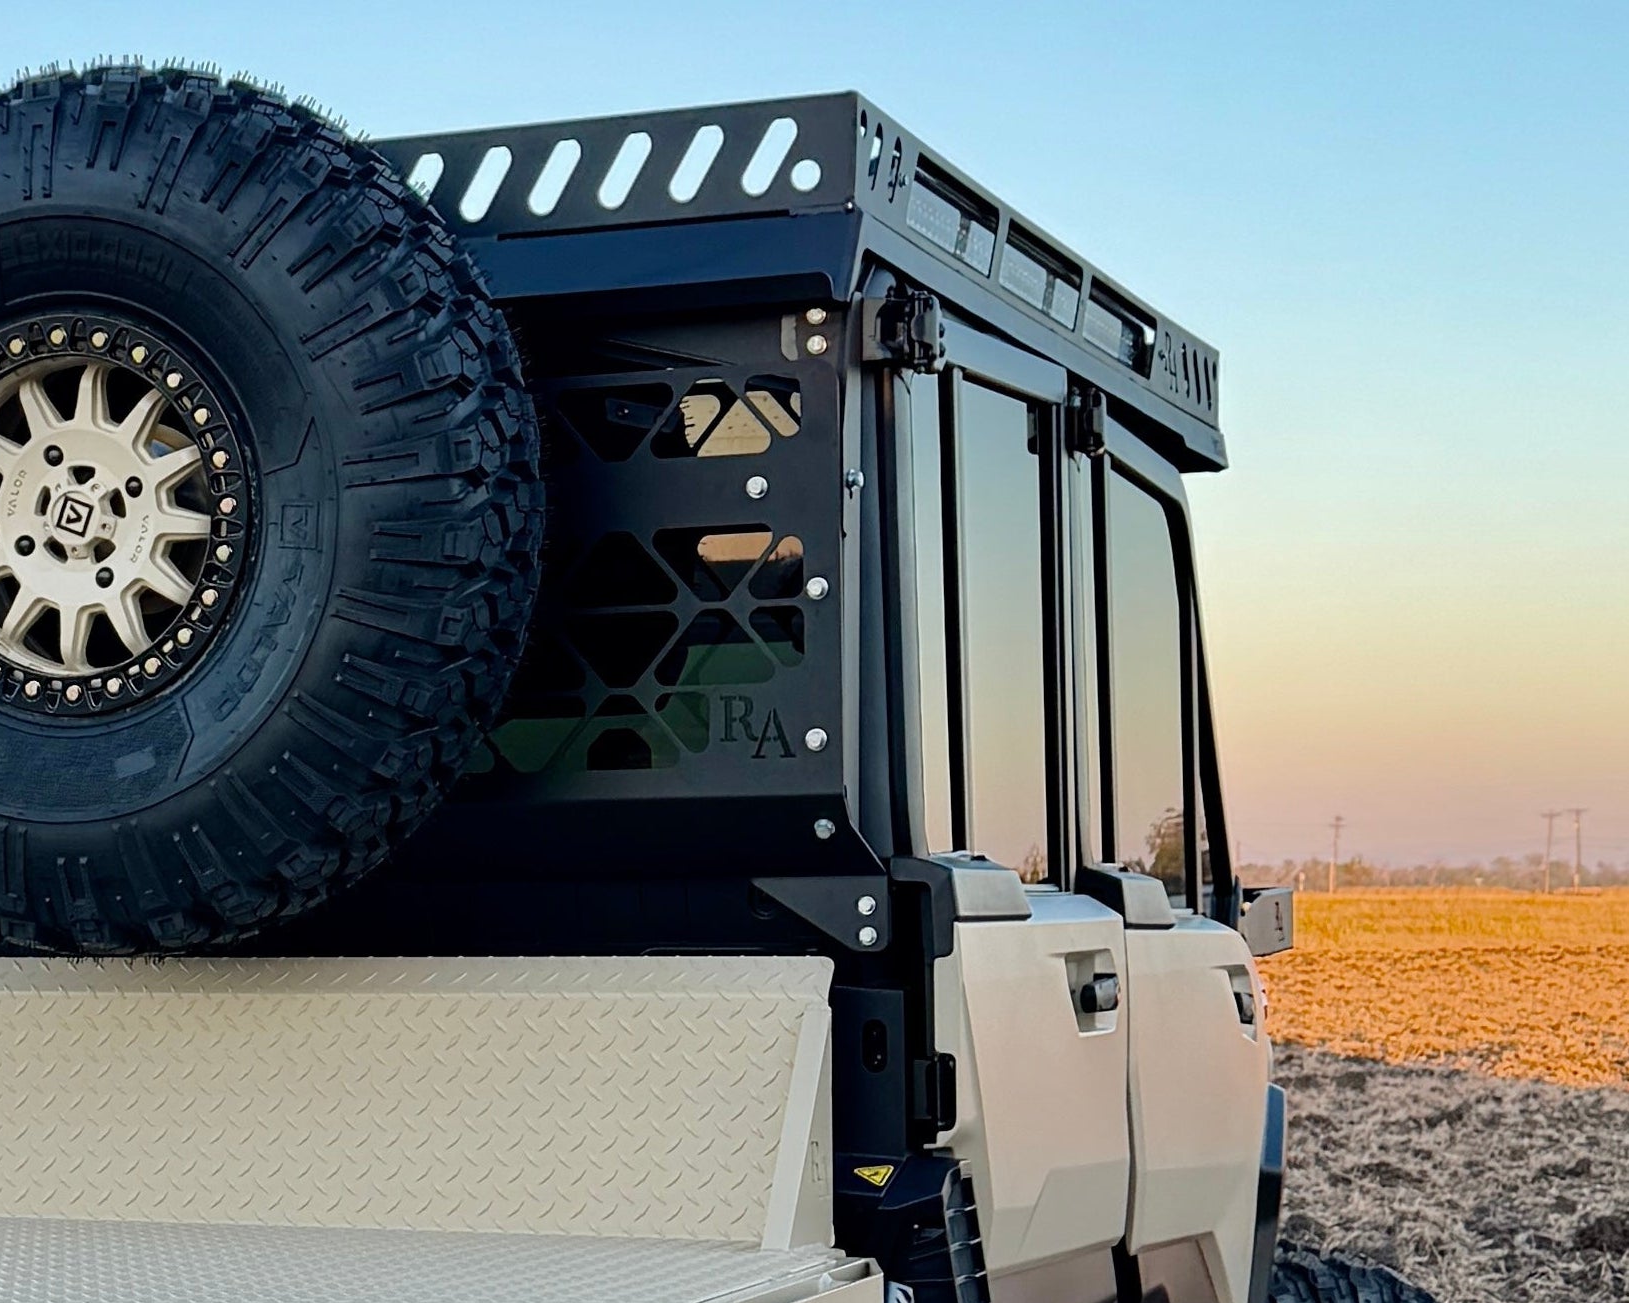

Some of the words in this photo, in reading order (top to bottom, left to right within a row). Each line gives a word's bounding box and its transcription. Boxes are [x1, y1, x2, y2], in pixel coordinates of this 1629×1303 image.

[6, 469, 28, 518] VALOR
[129, 513, 150, 564] VALOR
[719, 694, 798, 760] RA
